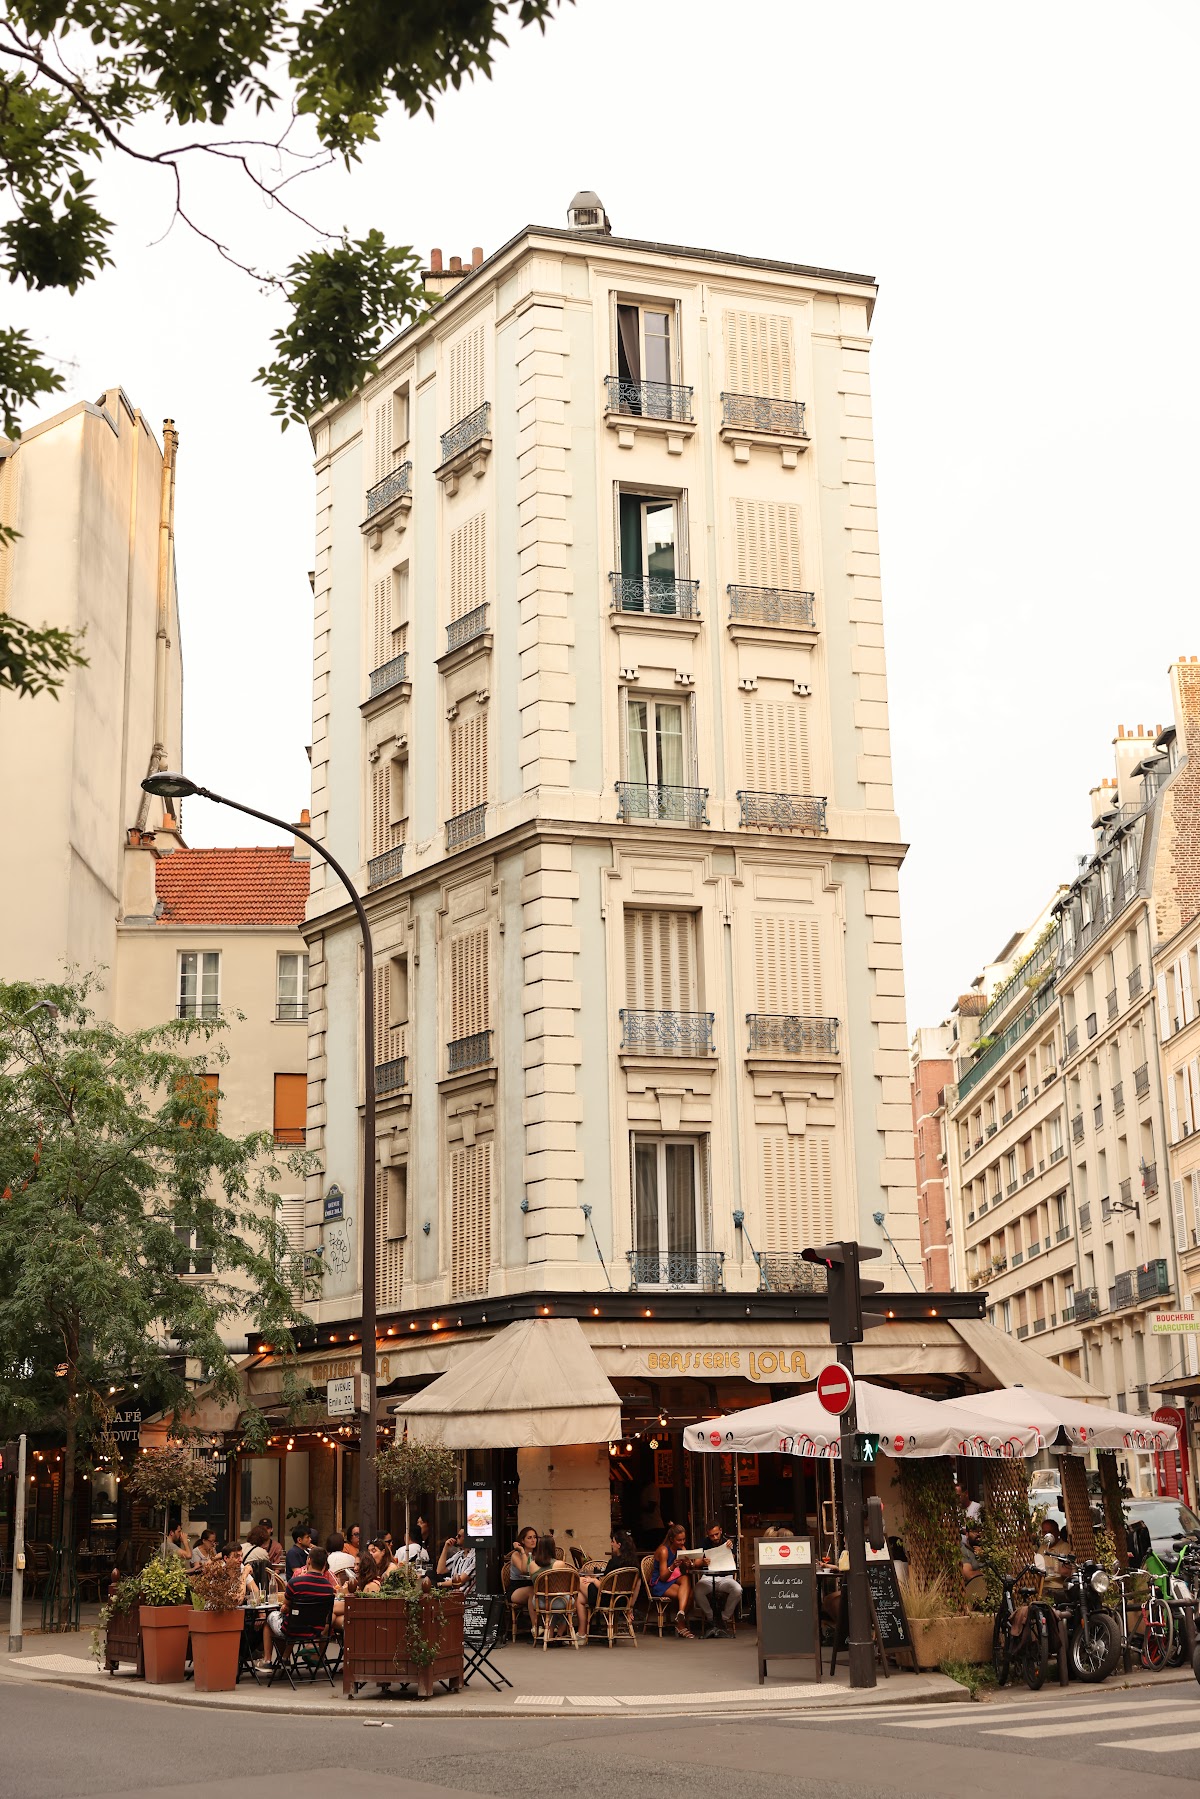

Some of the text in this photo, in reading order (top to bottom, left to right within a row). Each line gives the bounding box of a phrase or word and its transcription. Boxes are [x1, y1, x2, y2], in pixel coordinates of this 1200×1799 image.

[1156, 1314, 1194, 1322] BOUCHERIE
[1153, 1323, 1200, 1332] CHARCUTERIE
[312, 1361, 356, 1381] BRASSERIE
[648, 1351, 811, 1380] BRASSERIE LOLA
[334, 1381, 351, 1393] AVENUE
[344, 1394, 354, 1405] ZOL
